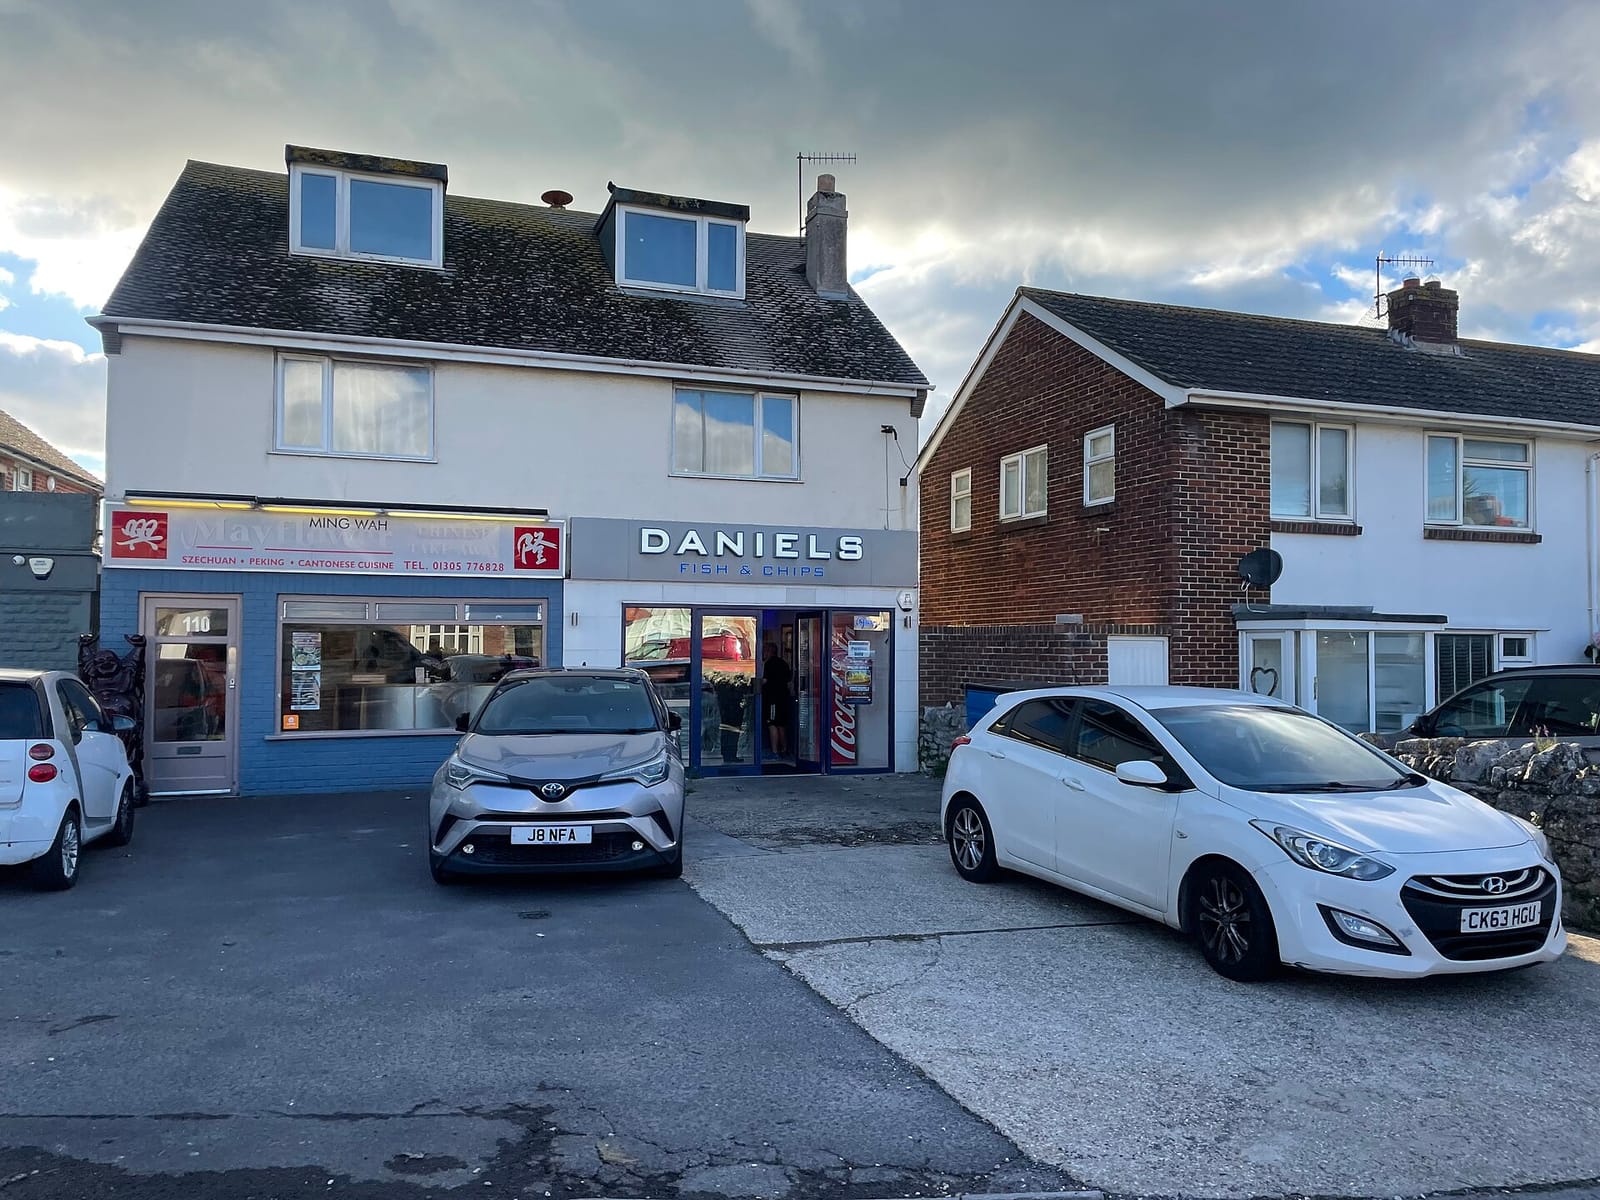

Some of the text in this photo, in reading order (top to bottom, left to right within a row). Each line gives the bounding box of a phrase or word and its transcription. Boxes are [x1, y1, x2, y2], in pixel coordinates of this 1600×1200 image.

[309, 517, 388, 531] MING WAH
[639, 527, 864, 561] DANIELS
[182, 555, 504, 571] SZECHUAN PEKING CANTONESE CUISINE TEL. 01305 776828
[680, 563, 824, 577] FISH & CHIPS
[182, 615, 210, 633] 110
[527, 828, 576, 842] J8 NFA
[1468, 905, 1536, 929] CK63 HGU
